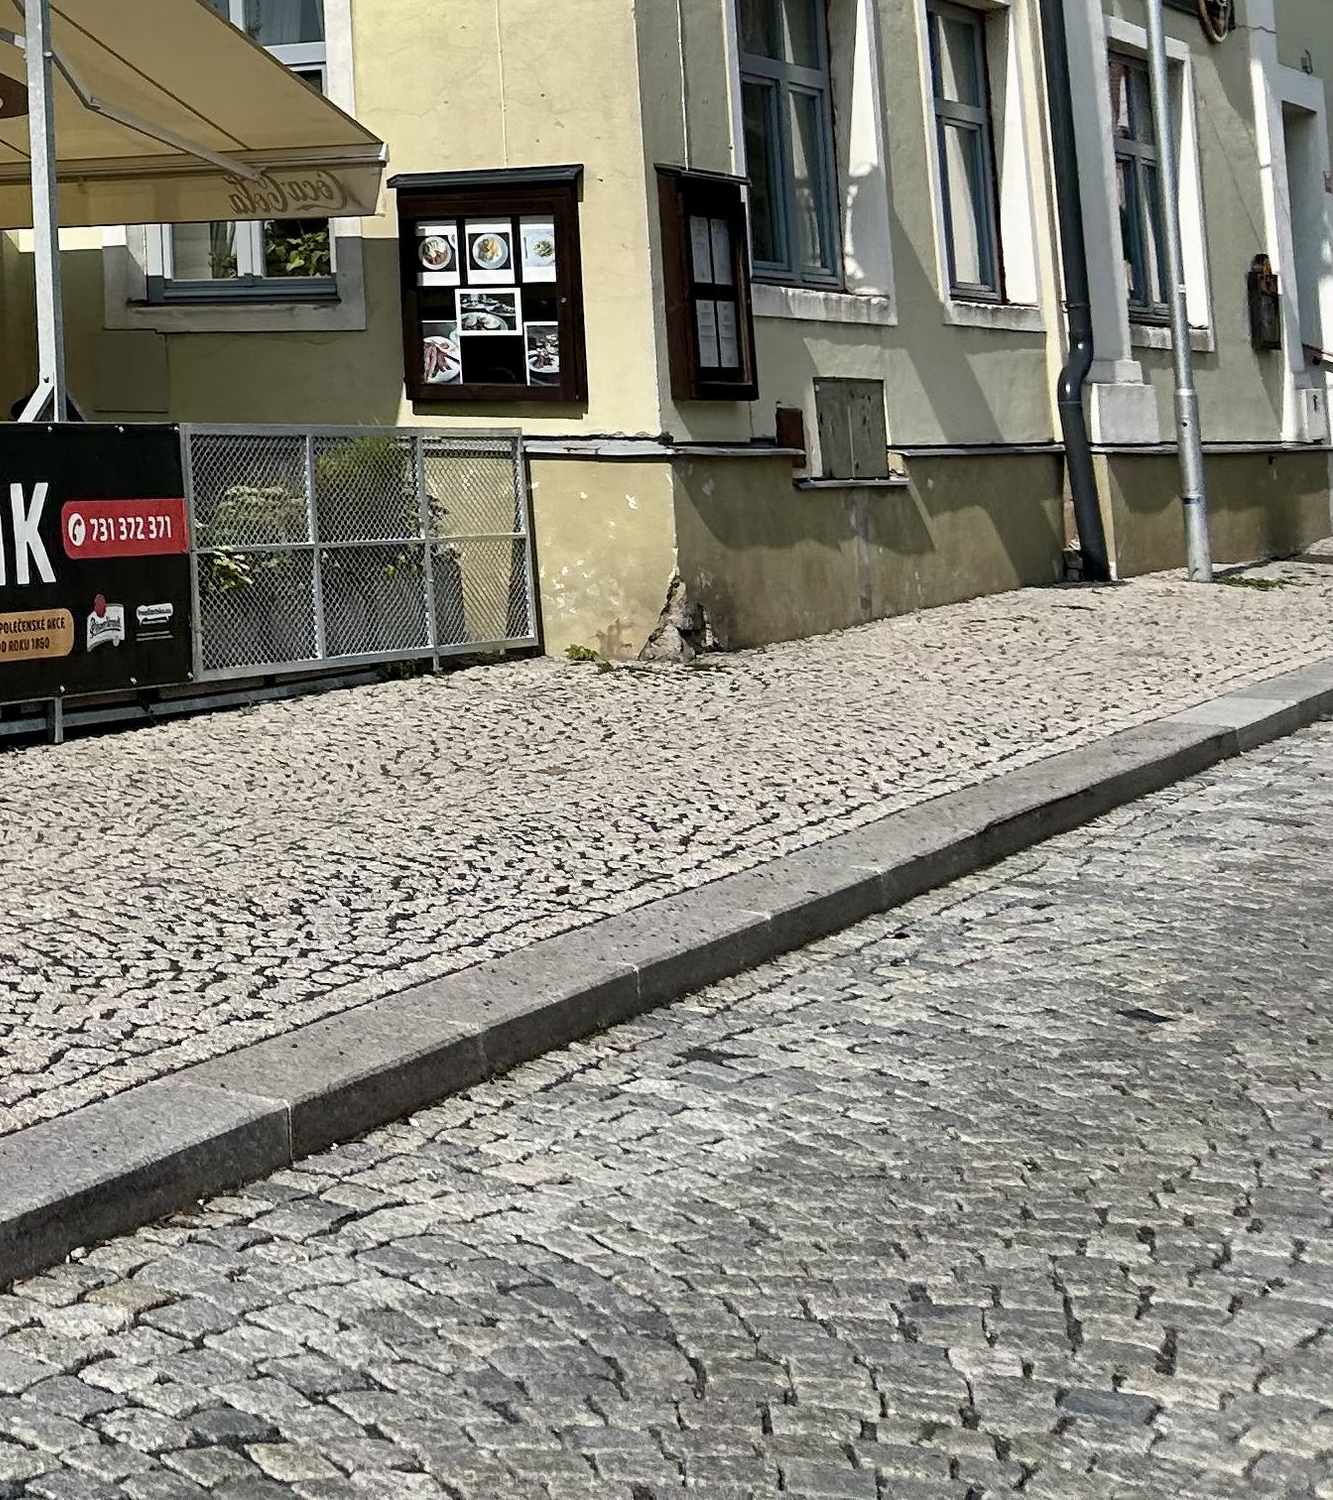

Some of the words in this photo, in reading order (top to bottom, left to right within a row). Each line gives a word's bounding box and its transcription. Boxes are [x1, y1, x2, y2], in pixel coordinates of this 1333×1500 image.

[90, 518, 115, 541] 731
[118, 516, 146, 541] 372
[148, 515, 172, 540] 371
[47, 616, 66, 630] AKCE
[8, 638, 30, 653] ROKU
[32, 636, 51, 651] 1860
